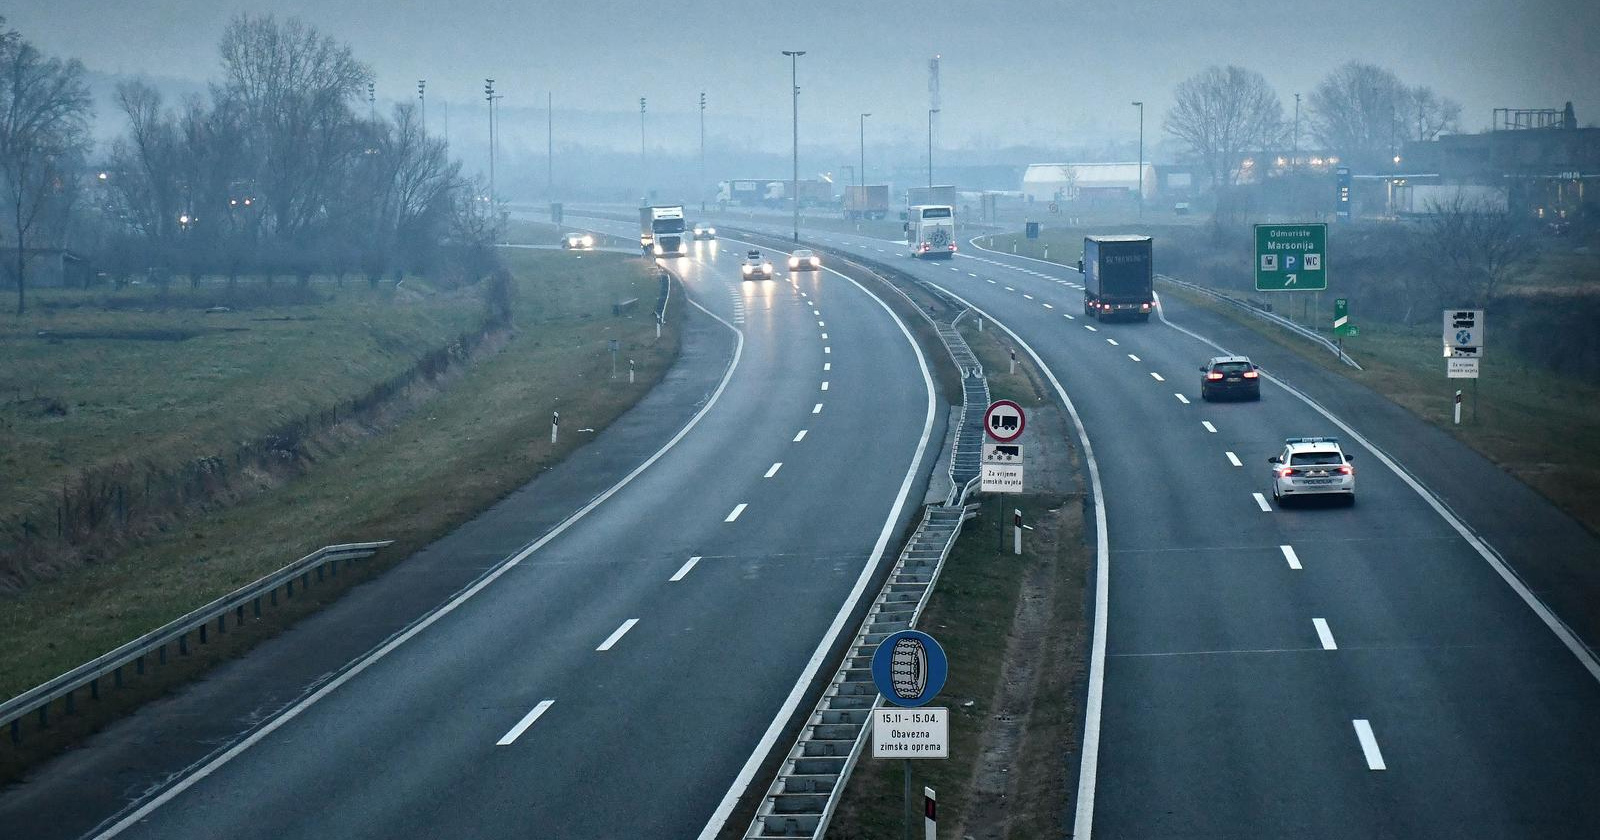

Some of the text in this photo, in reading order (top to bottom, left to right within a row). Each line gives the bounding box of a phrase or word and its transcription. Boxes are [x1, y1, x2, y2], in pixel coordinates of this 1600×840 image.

[1267, 241, 1314, 251] Marsonija
[1286, 256, 1296, 269] P
[1305, 257, 1318, 266] WC
[882, 714, 902, 723] 15.11
[912, 714, 939, 723] 15.04.
[891, 729, 930, 739] Obavezna
[880, 742, 941, 752] zimska oprema
